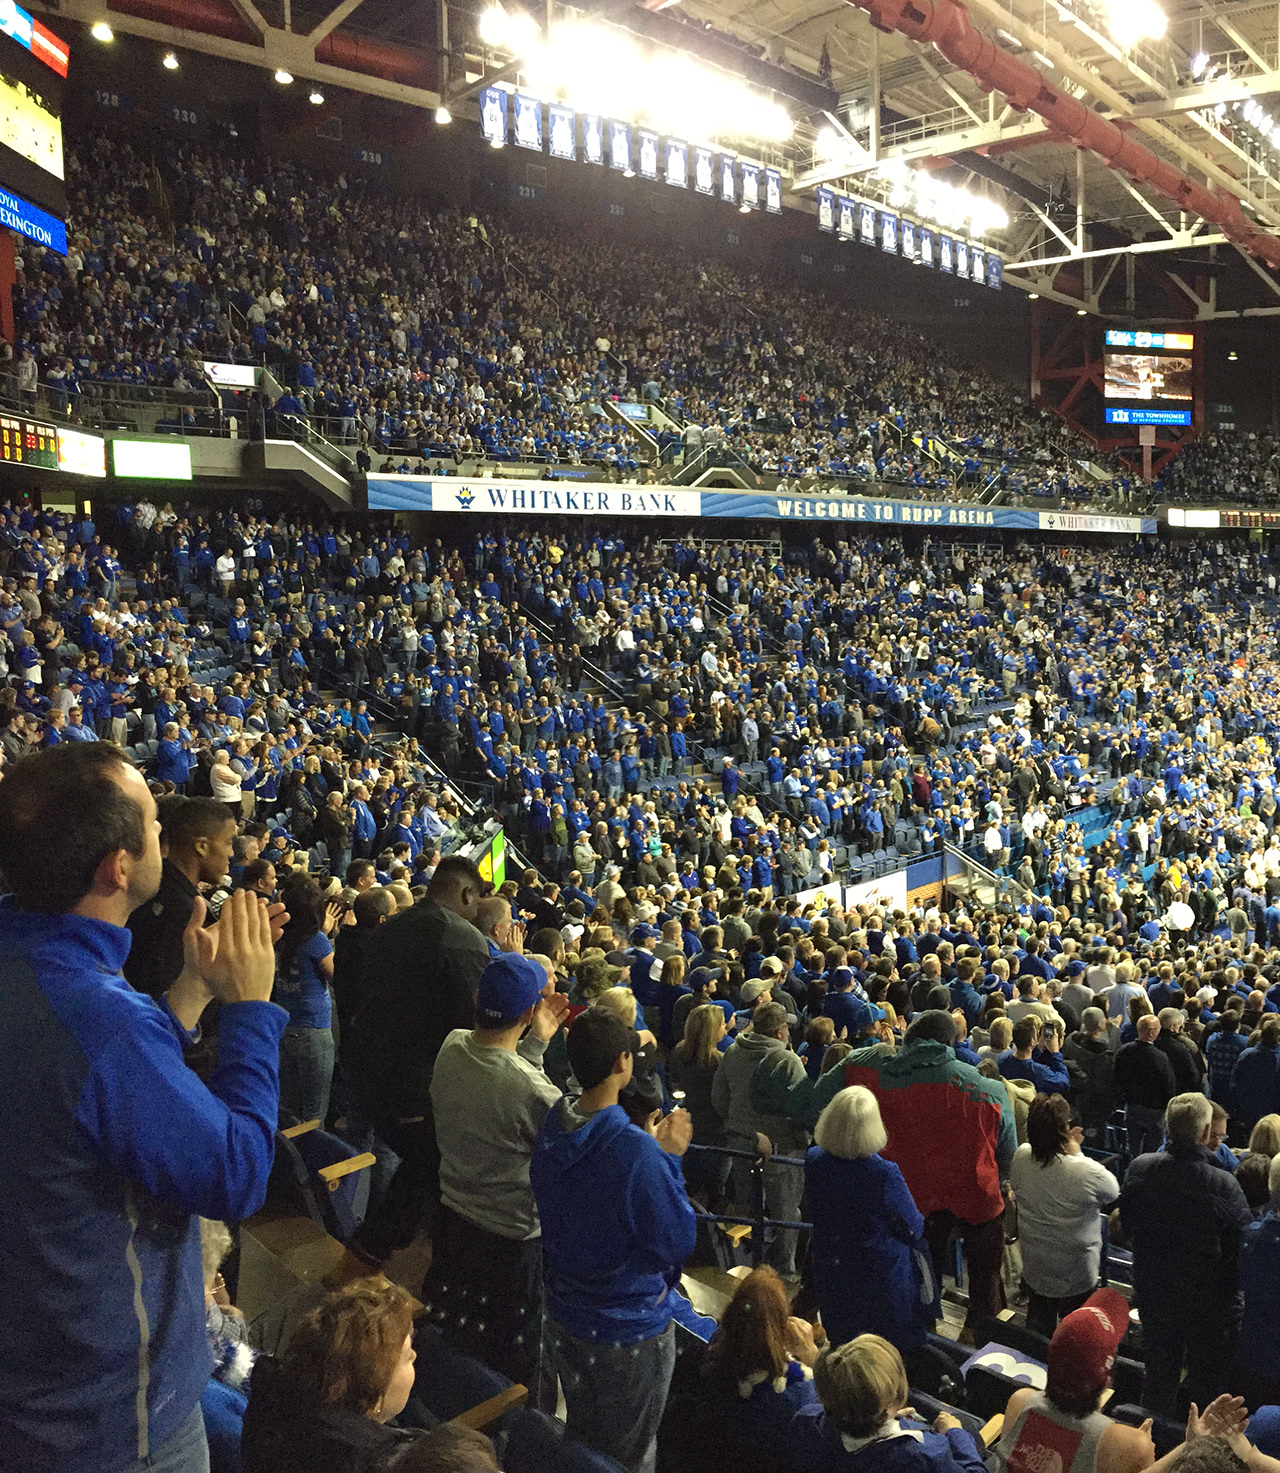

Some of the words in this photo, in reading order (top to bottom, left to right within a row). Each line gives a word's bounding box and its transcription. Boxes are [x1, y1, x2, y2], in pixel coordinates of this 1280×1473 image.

[173, 108, 197, 124] 230
[361, 150, 382, 165] 230
[519, 185, 536, 199] 231
[1, 207, 52, 246] EXINGTON
[487, 488, 610, 511] WHITAKER
[621, 492, 677, 512] BANK
[777, 499, 865, 519] WELCOME
[874, 504, 893, 520] TO
[902, 506, 942, 523] RUPP
[949, 508, 994, 525] ARENA
[1110, 517, 1132, 530] BANK
